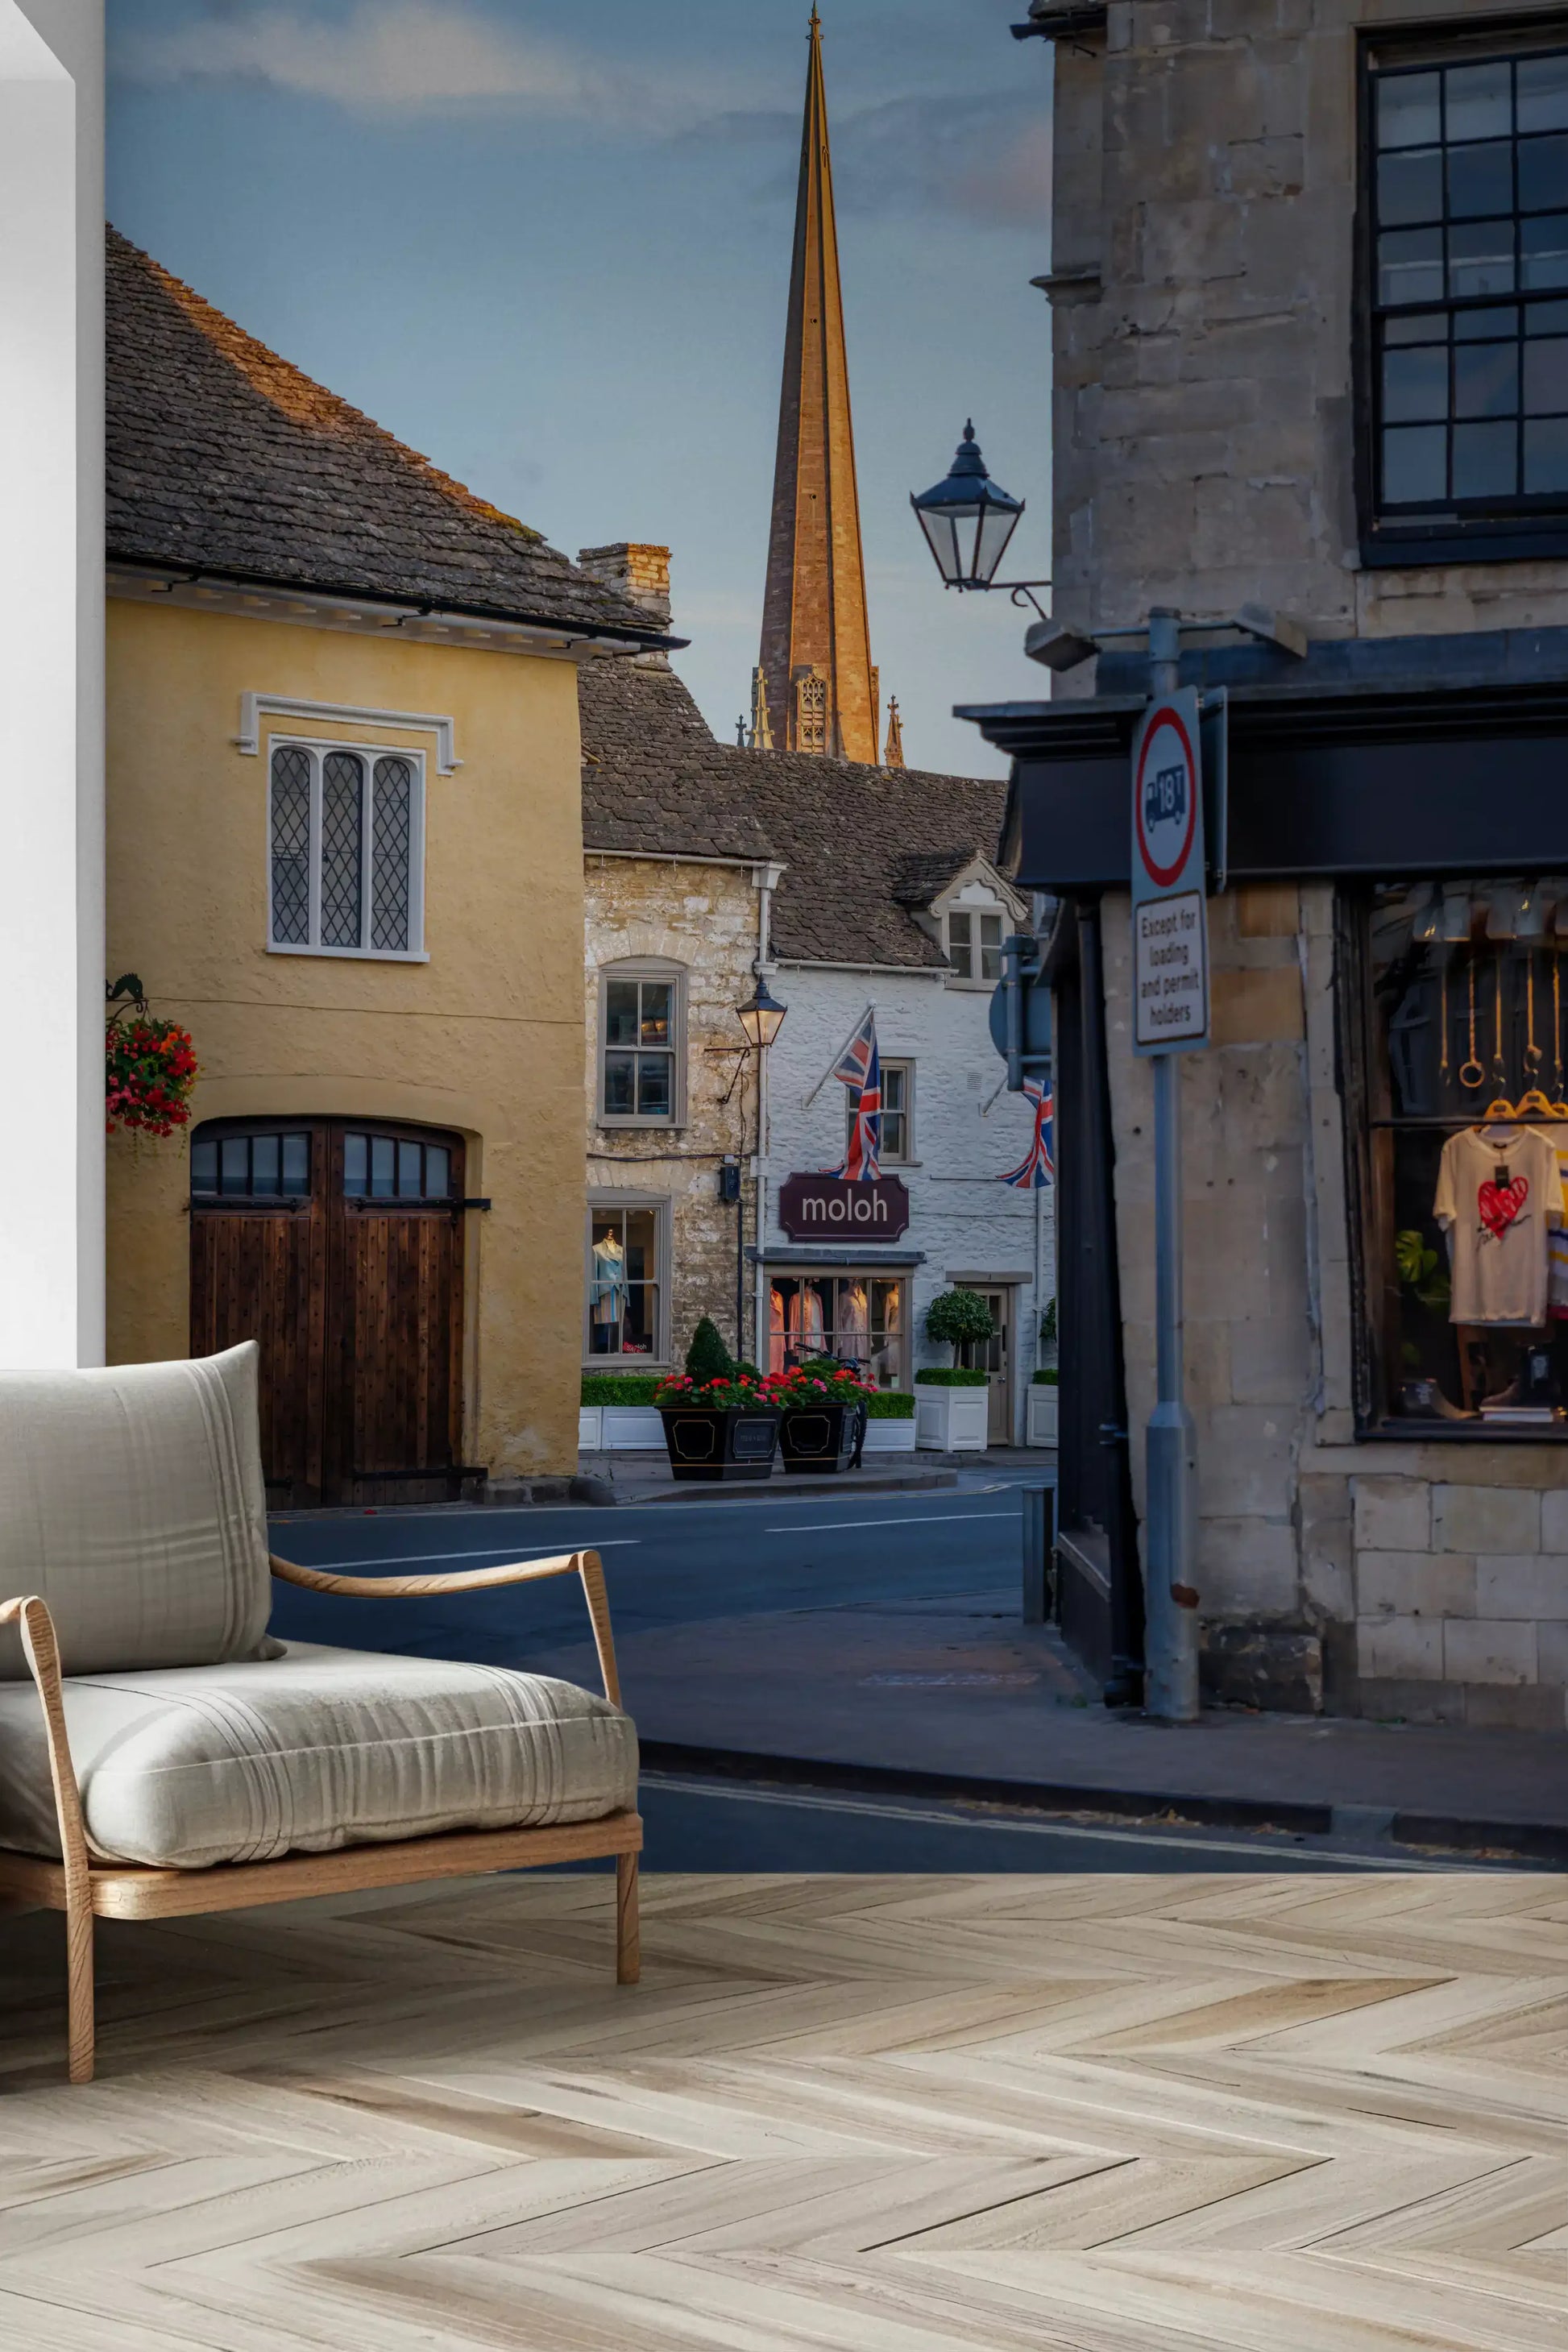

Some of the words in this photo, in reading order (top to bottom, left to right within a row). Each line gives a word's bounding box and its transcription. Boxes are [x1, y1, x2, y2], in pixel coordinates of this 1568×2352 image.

[1159, 774, 1175, 812] 18
[1142, 912, 1177, 938] Except
[1180, 909, 1196, 930] for
[1150, 942, 1189, 967] loading
[1141, 975, 1161, 998] and
[1164, 969, 1199, 998] permit
[1150, 1002, 1192, 1027] holders
[803, 1188, 887, 1222] moloh
